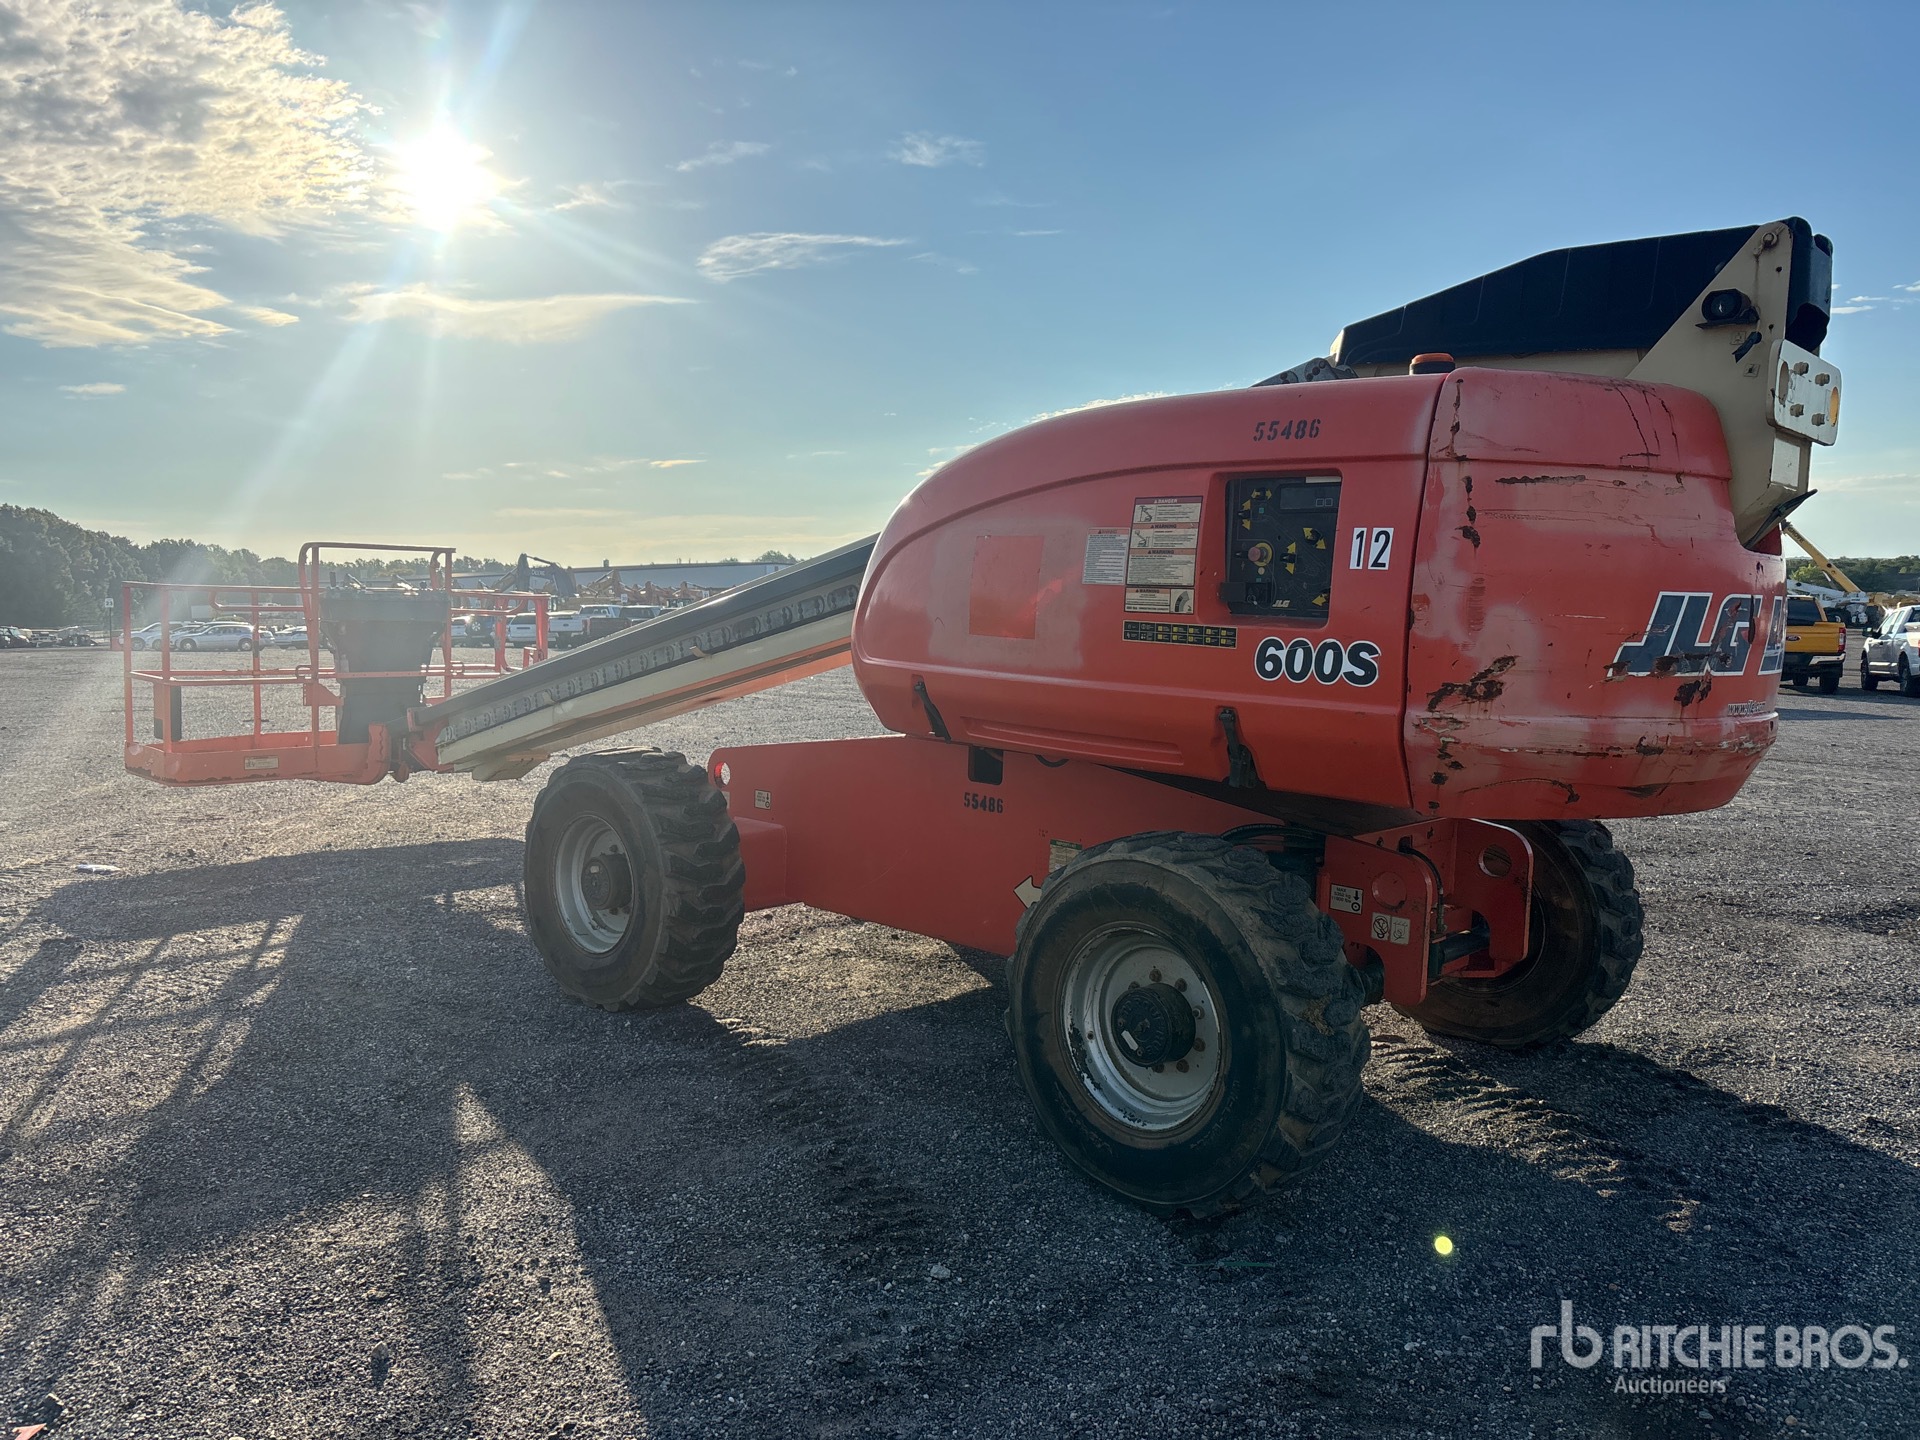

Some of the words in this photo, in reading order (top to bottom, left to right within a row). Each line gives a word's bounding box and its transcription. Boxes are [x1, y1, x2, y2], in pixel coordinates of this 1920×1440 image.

[1252, 418, 1322, 442] 55486
[1788, 527, 1805, 543] GROVE
[1354, 530, 1391, 568] 12
[1271, 599, 1291, 608] JLG
[1606, 591, 1763, 677] JLG
[1254, 636, 1381, 687] 600S
[963, 792, 1004, 814] 55486
